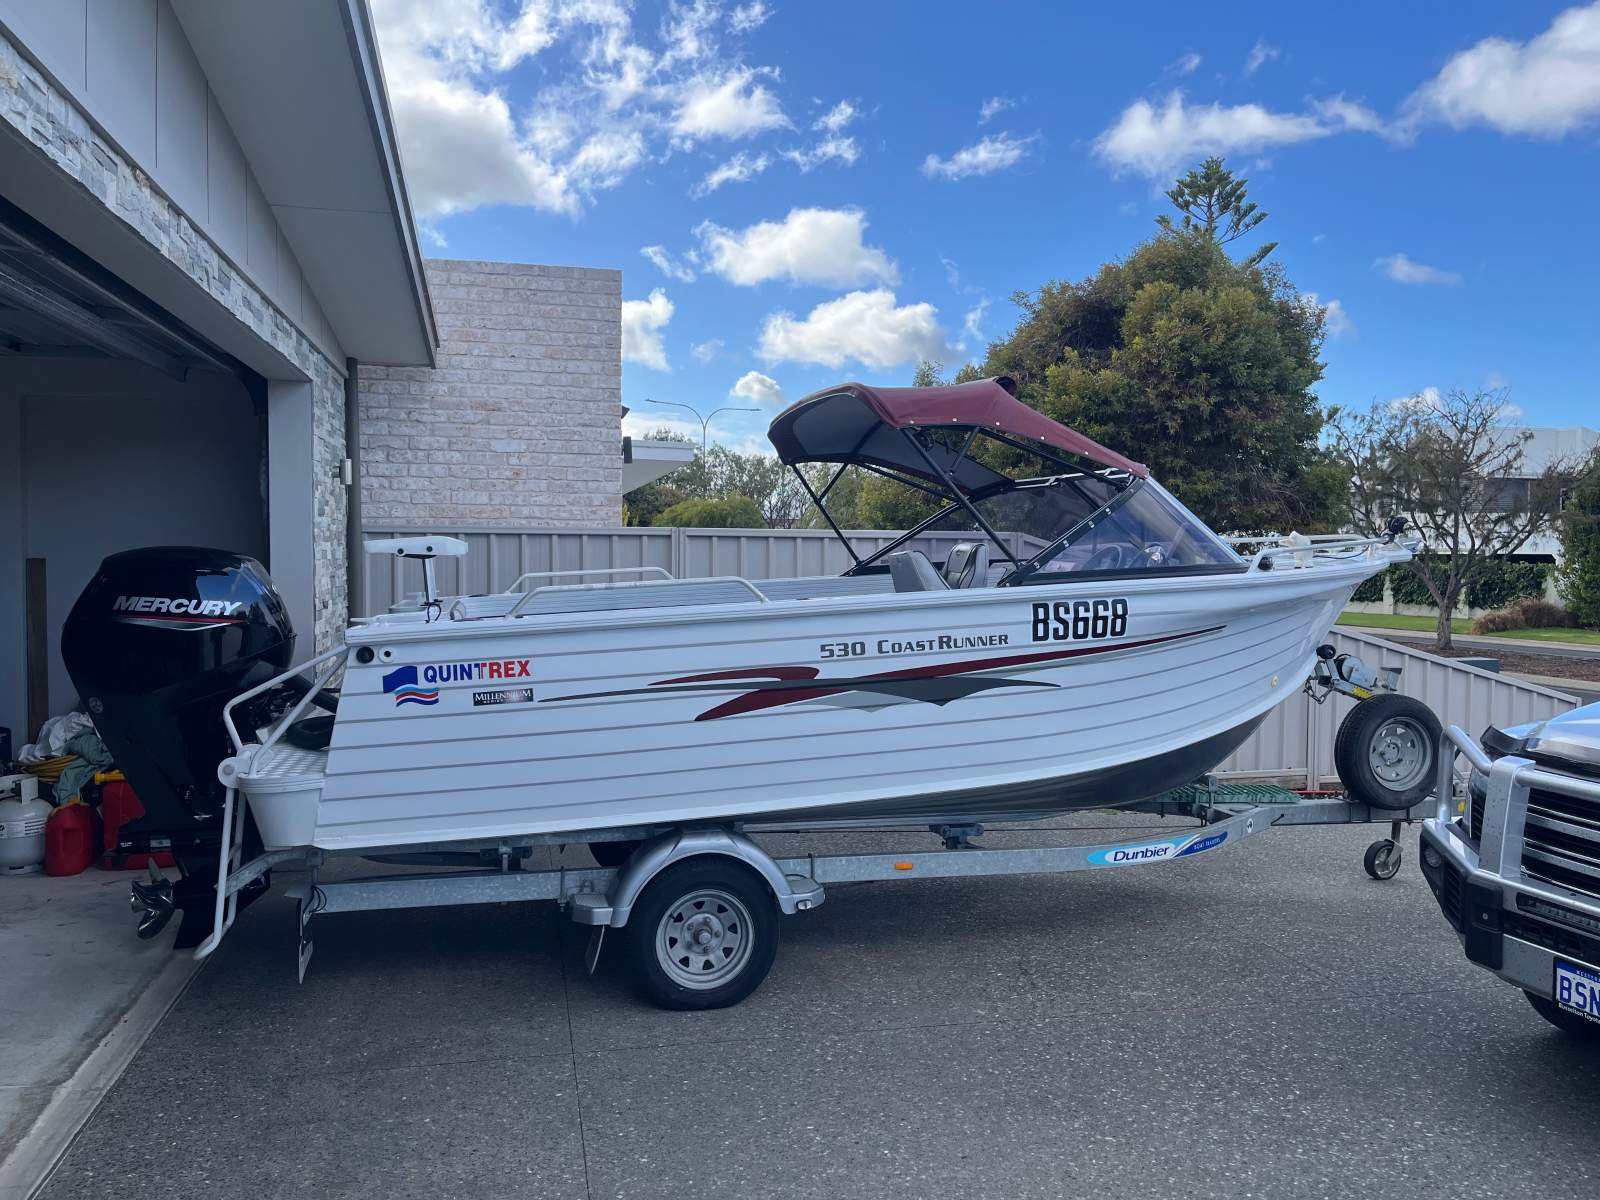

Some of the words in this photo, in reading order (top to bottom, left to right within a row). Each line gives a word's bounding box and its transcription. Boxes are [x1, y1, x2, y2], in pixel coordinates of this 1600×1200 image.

[112, 595, 242, 616] MERCURY
[1031, 598, 1129, 642] BS668
[820, 641, 866, 659] 530
[423, 659, 531, 683] QUINTREX
[1113, 846, 1170, 862] Dunbier
